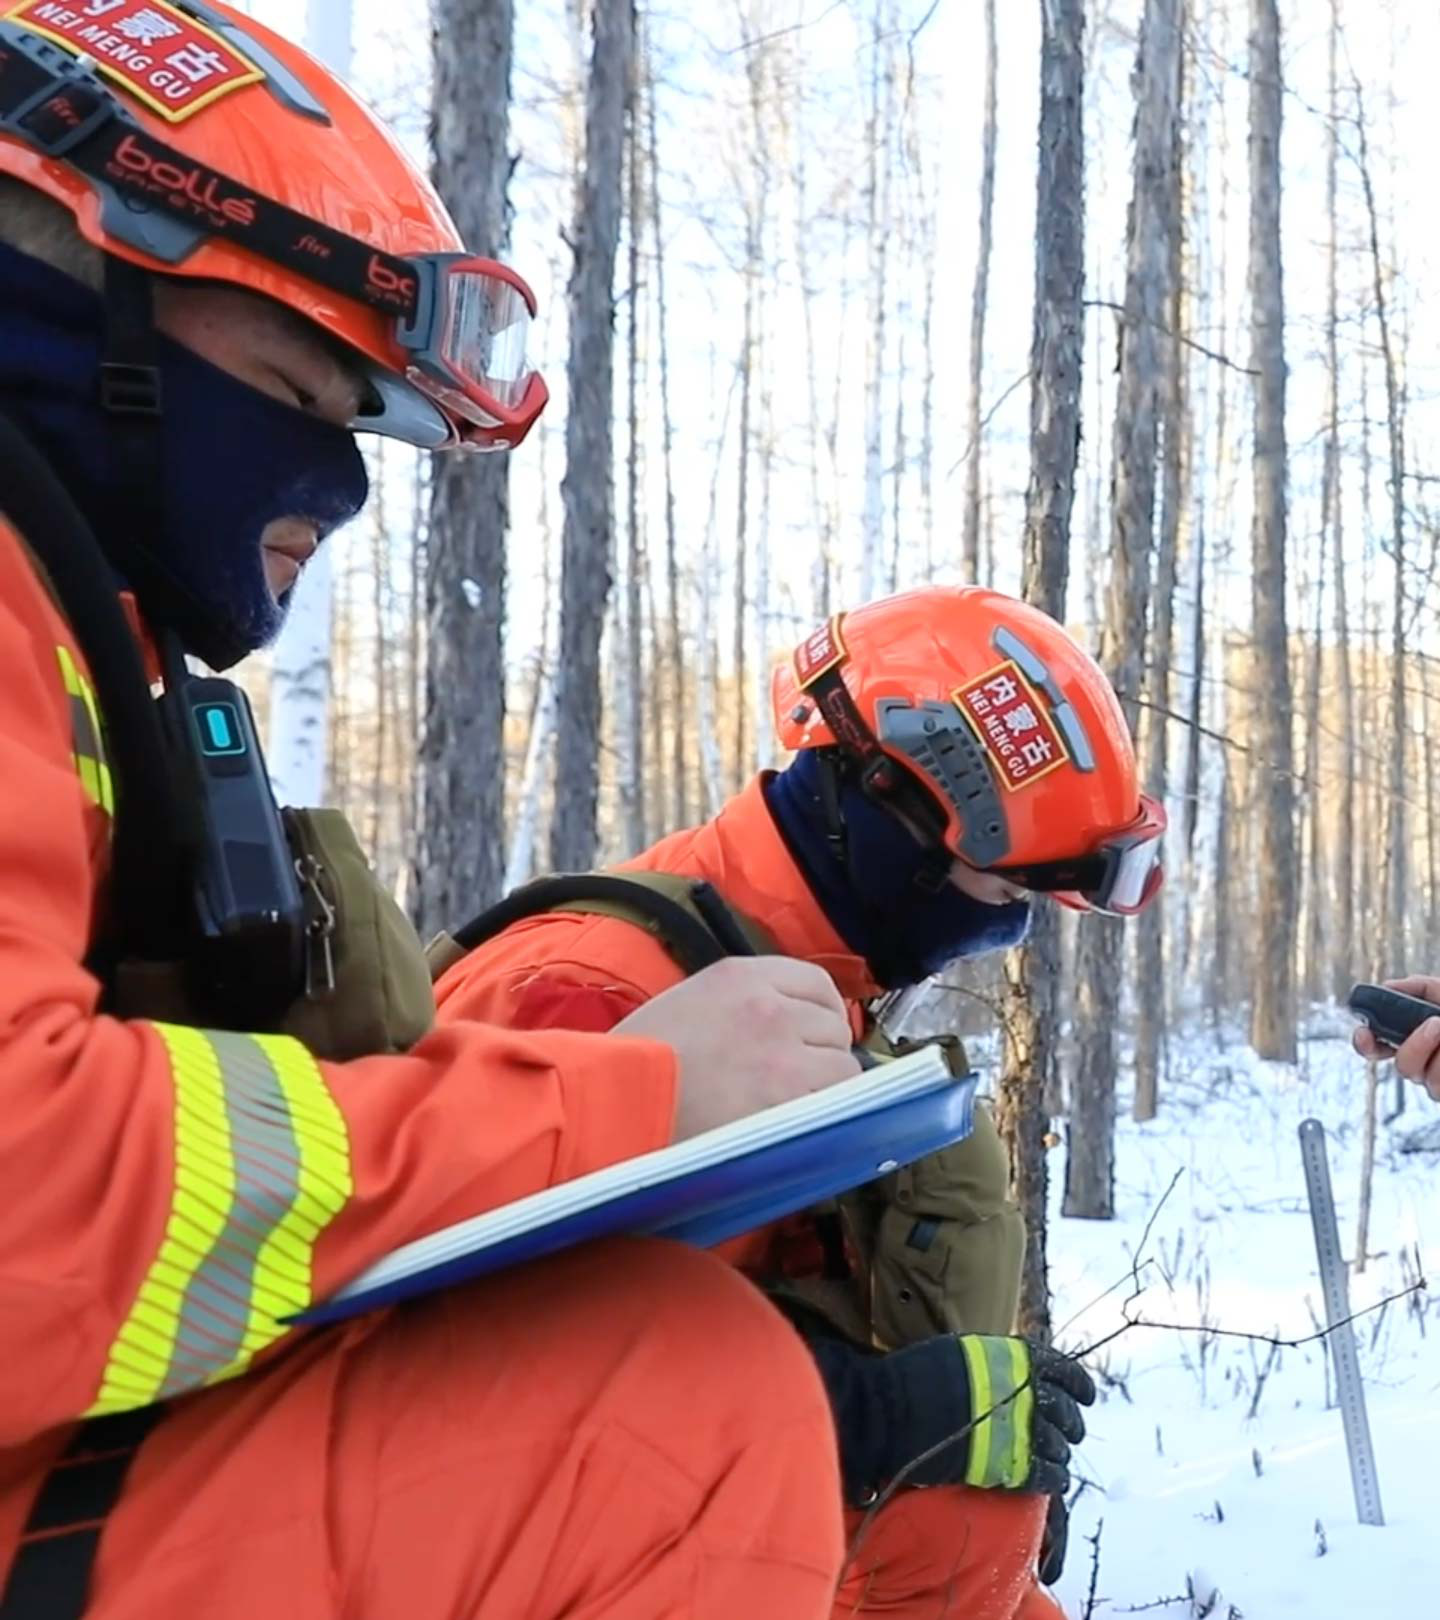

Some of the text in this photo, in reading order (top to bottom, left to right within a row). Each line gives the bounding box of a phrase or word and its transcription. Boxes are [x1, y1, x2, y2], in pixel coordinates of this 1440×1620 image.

[34, 3, 192, 99] NEI MENG GU
[115, 134, 256, 225] bollé
[966, 688, 1028, 777] NEI MENG GU
[983, 675, 1052, 767] 内蒙古
